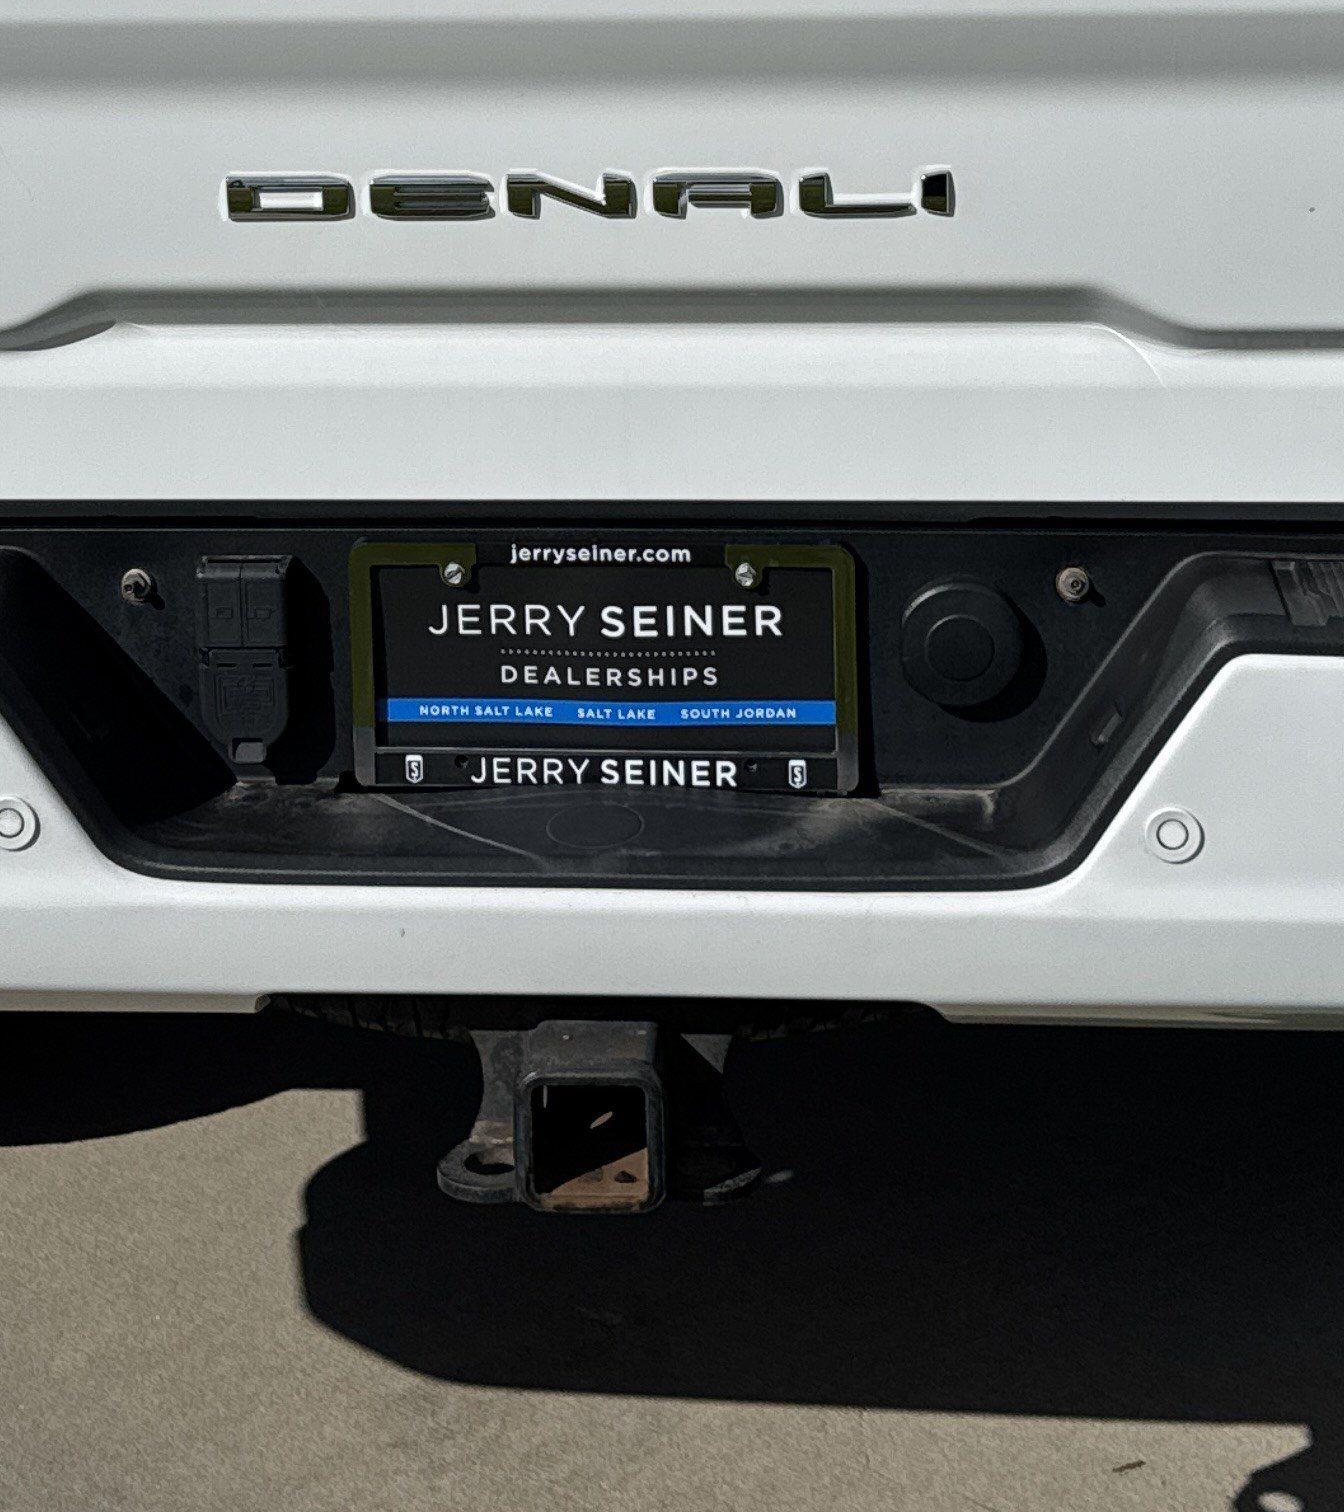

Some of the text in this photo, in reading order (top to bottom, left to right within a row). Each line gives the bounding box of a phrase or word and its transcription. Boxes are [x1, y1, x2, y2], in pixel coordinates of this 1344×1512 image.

[226, 171, 955, 220] DENALI
[509, 543, 692, 564] jerryseiner.com
[428, 604, 783, 637] JERRY SEINER
[501, 665, 718, 687] DEALERSHIPS
[419, 705, 797, 720] NORTH SALT LAKE SALT LAKE SOUTH JORDAN
[471, 757, 737, 787] JERRY SEINER
